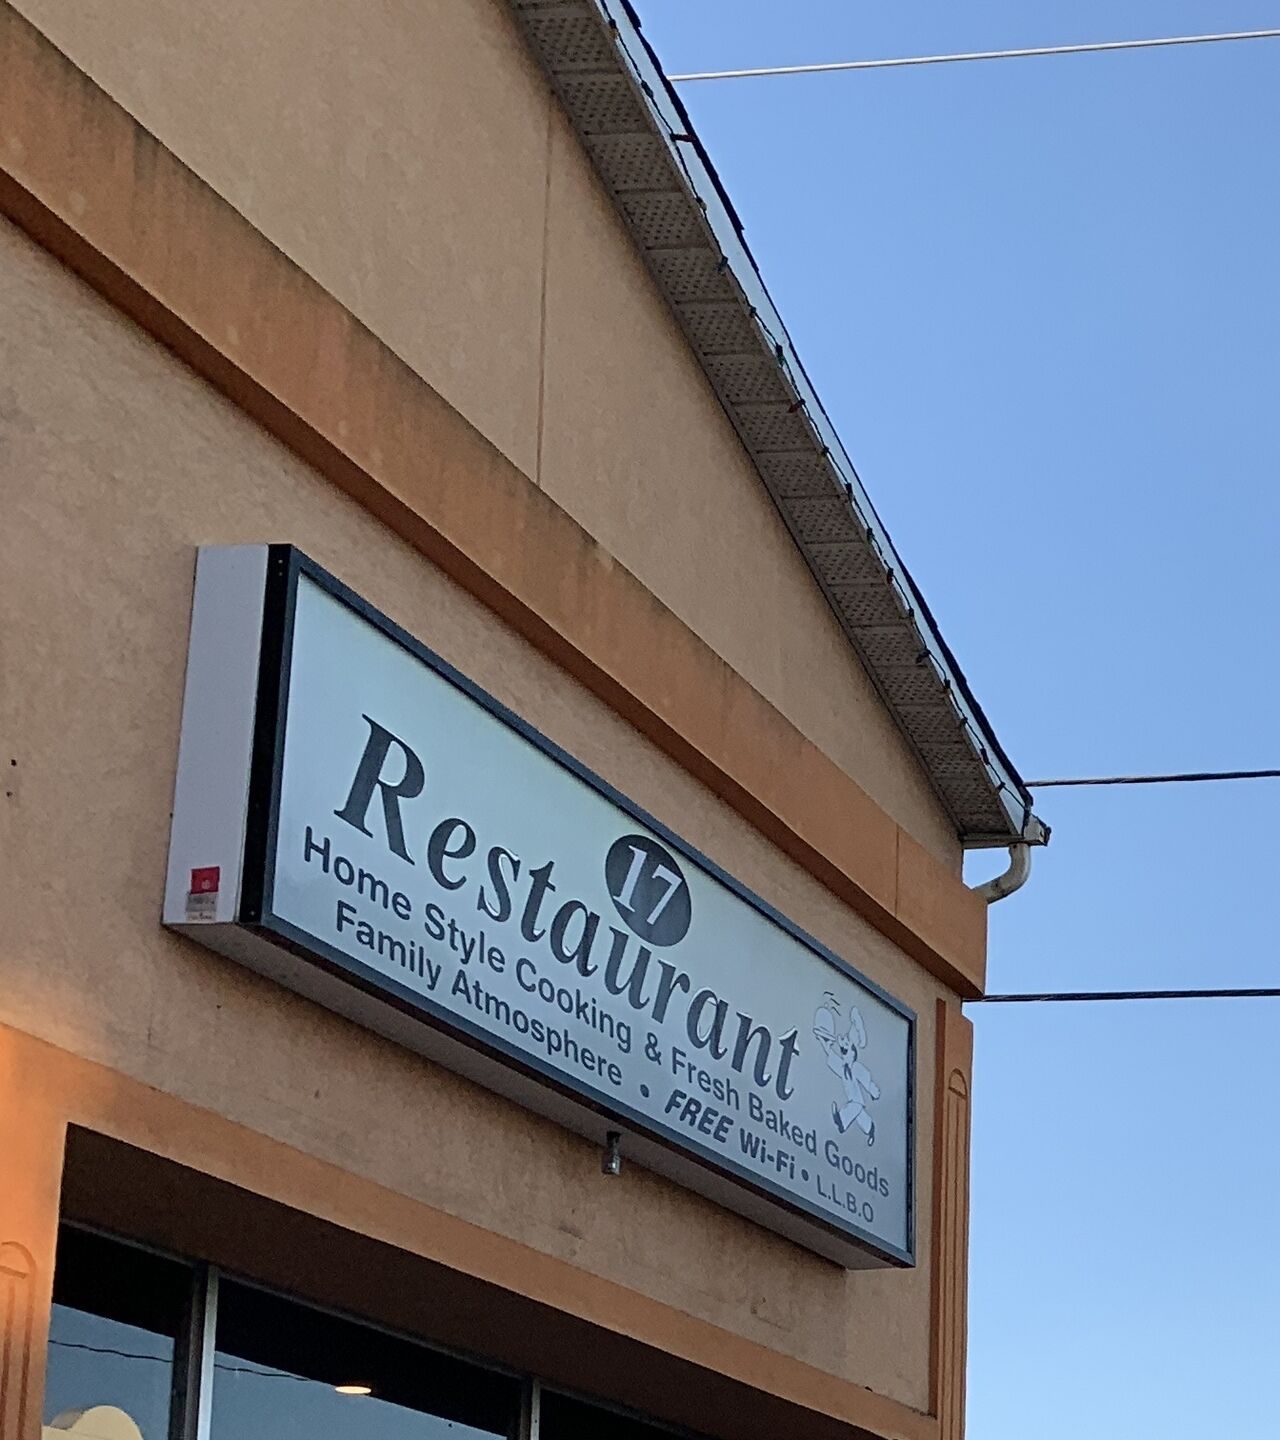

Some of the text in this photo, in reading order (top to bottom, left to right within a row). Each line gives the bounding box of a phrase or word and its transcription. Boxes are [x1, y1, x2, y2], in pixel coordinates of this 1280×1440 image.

[303, 825, 890, 1198] Home Style Cooking & Fresh Baked Goods
[333, 713, 801, 1100] Restaurant
[336, 900, 442, 990] Family
[451, 968, 623, 1086] Atmosphere
[664, 1088, 733, 1144] FREE
[739, 1127, 796, 1180] Wi-Fi
[613, 845, 683, 926] 17
